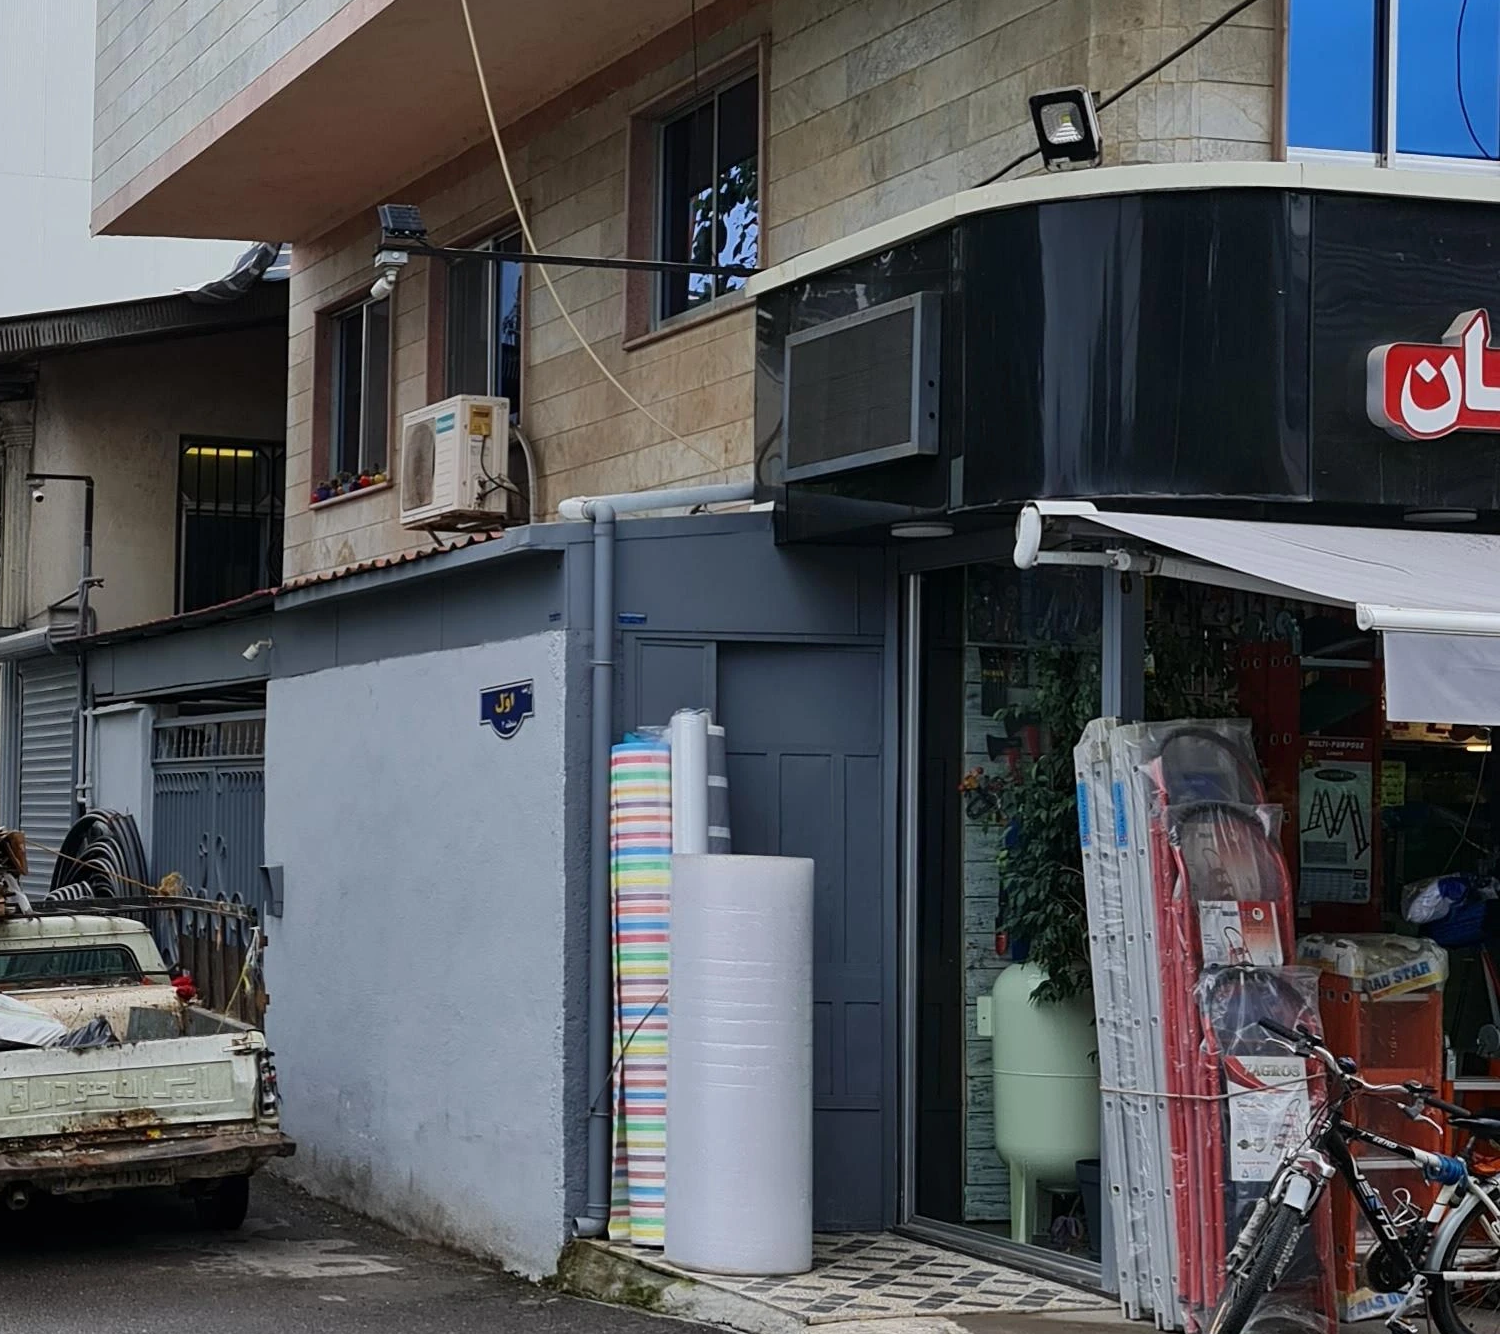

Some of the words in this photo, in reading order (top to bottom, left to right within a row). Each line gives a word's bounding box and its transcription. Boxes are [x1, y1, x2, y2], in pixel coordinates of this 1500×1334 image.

[1401, 316, 1500, 434] ان
[1393, 961, 1432, 984] STAR
[1244, 1063, 1301, 1078] ZAGROS
